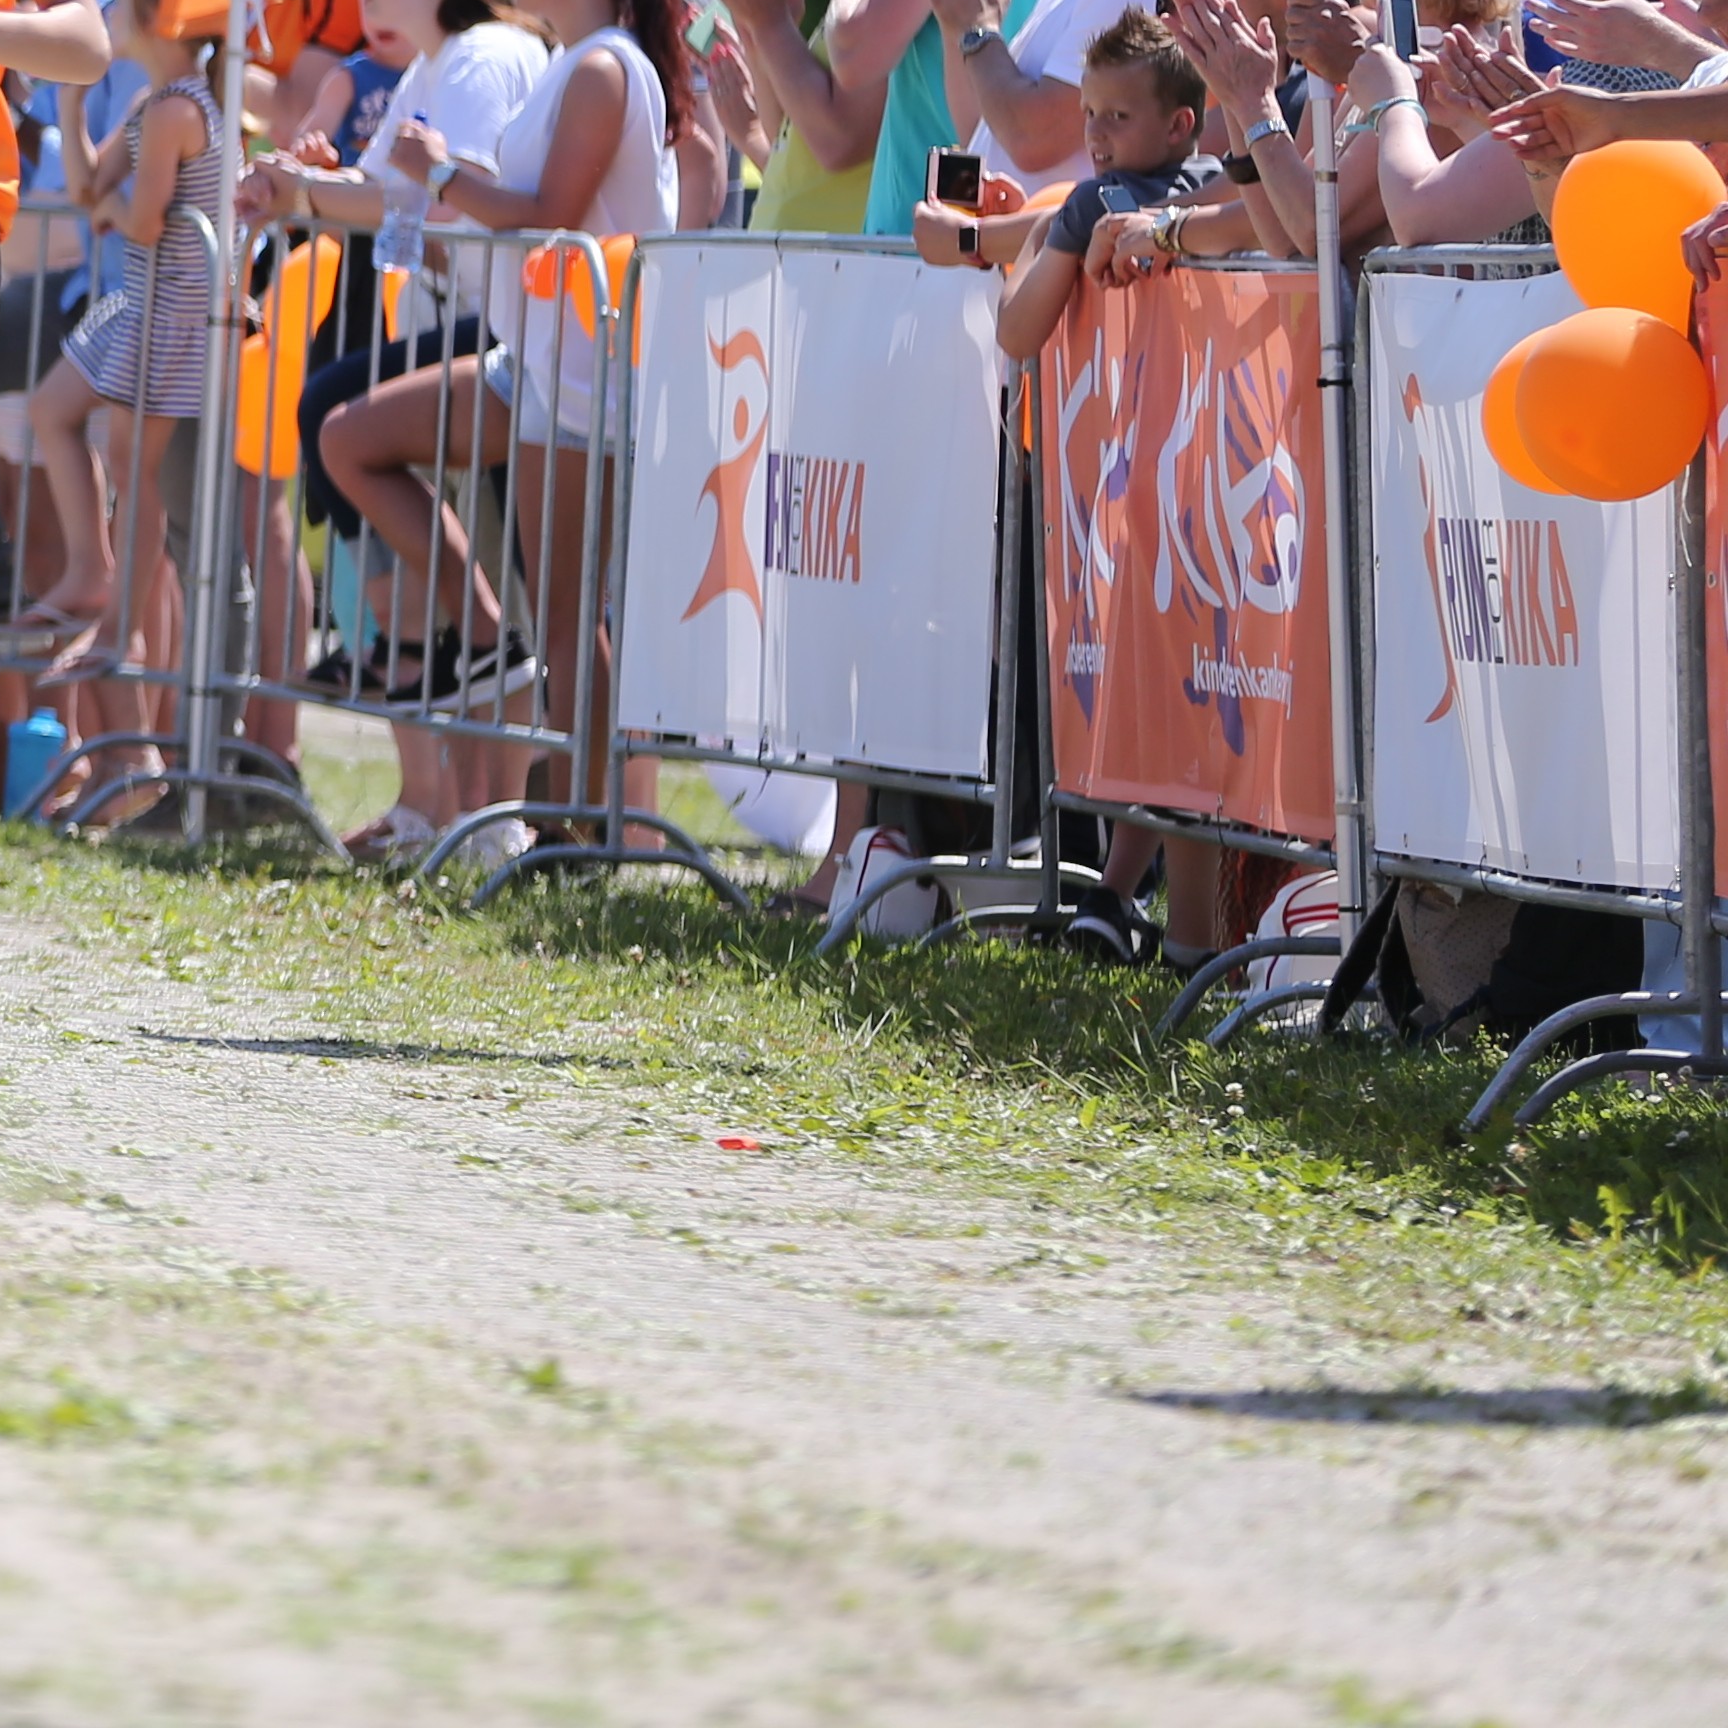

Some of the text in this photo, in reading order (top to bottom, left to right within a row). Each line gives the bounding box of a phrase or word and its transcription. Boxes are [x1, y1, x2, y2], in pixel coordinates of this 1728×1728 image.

[800, 457, 865, 585] KIKA
[1438, 517, 1493, 664] RUN
[1495, 519, 1579, 667] KIKA
